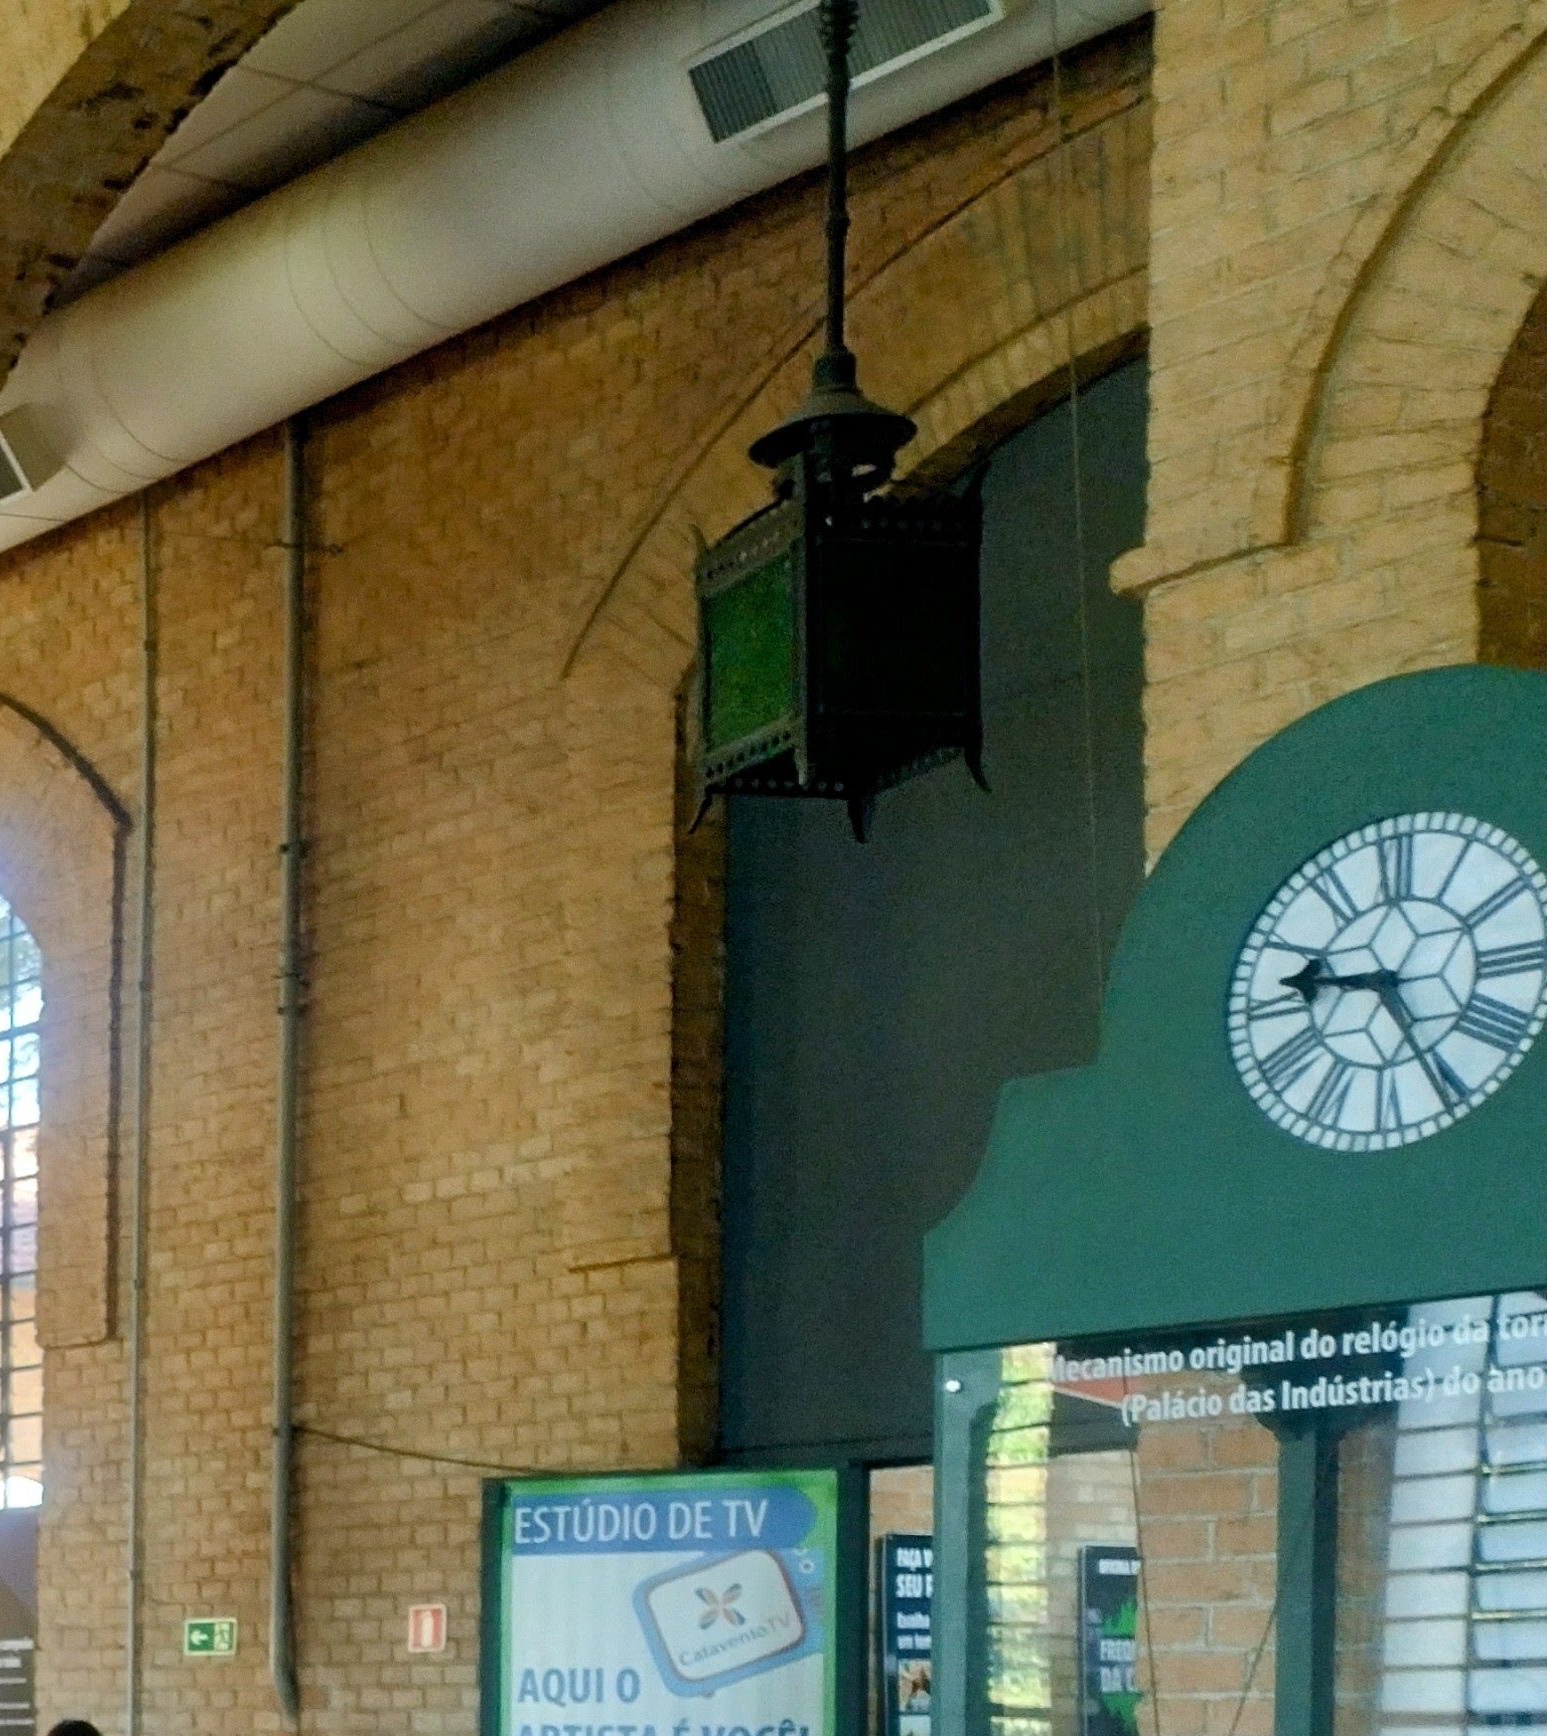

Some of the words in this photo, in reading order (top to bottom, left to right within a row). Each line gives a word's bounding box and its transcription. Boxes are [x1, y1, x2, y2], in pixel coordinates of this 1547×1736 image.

[1189, 1329, 1295, 1375] original
[1300, 1328, 1336, 1360] do
[1342, 1319, 1445, 1359] relógio
[1453, 1314, 1489, 1345] da
[1121, 1386, 1223, 1427] (Palácio
[1229, 1383, 1275, 1414] das
[1281, 1366, 1435, 1411] Indústrias)
[1442, 1365, 1481, 1396] do
[1487, 1366, 1545, 1394] ano
[514, 1497, 657, 1544] ESTÚDIO
[668, 1501, 713, 1540] DE
[722, 1498, 768, 1538] TV
[679, 1625, 769, 1667] Catavento
[767, 1613, 791, 1638] TV
[517, 1667, 605, 1707] AQUI
[616, 1667, 641, 1703] O
